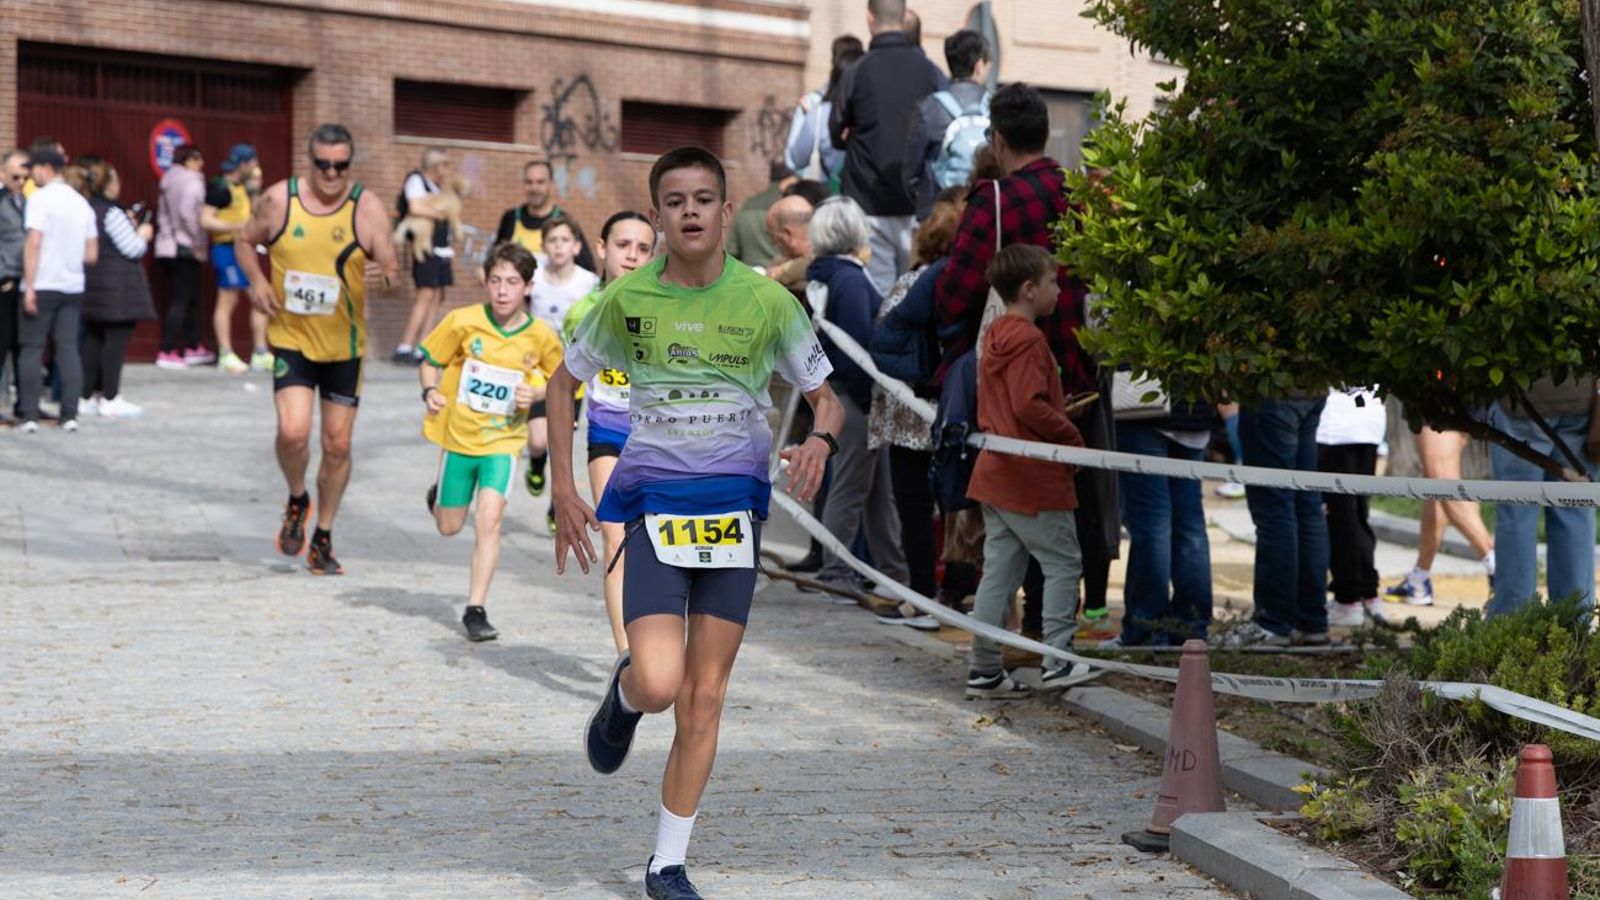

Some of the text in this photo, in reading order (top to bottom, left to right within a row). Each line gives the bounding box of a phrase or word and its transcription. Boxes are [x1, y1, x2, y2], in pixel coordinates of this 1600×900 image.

[294, 288, 325, 304] 461
[708, 352, 749, 365] IMPULS
[469, 378, 508, 401] 220
[658, 518, 744, 546] 1154
